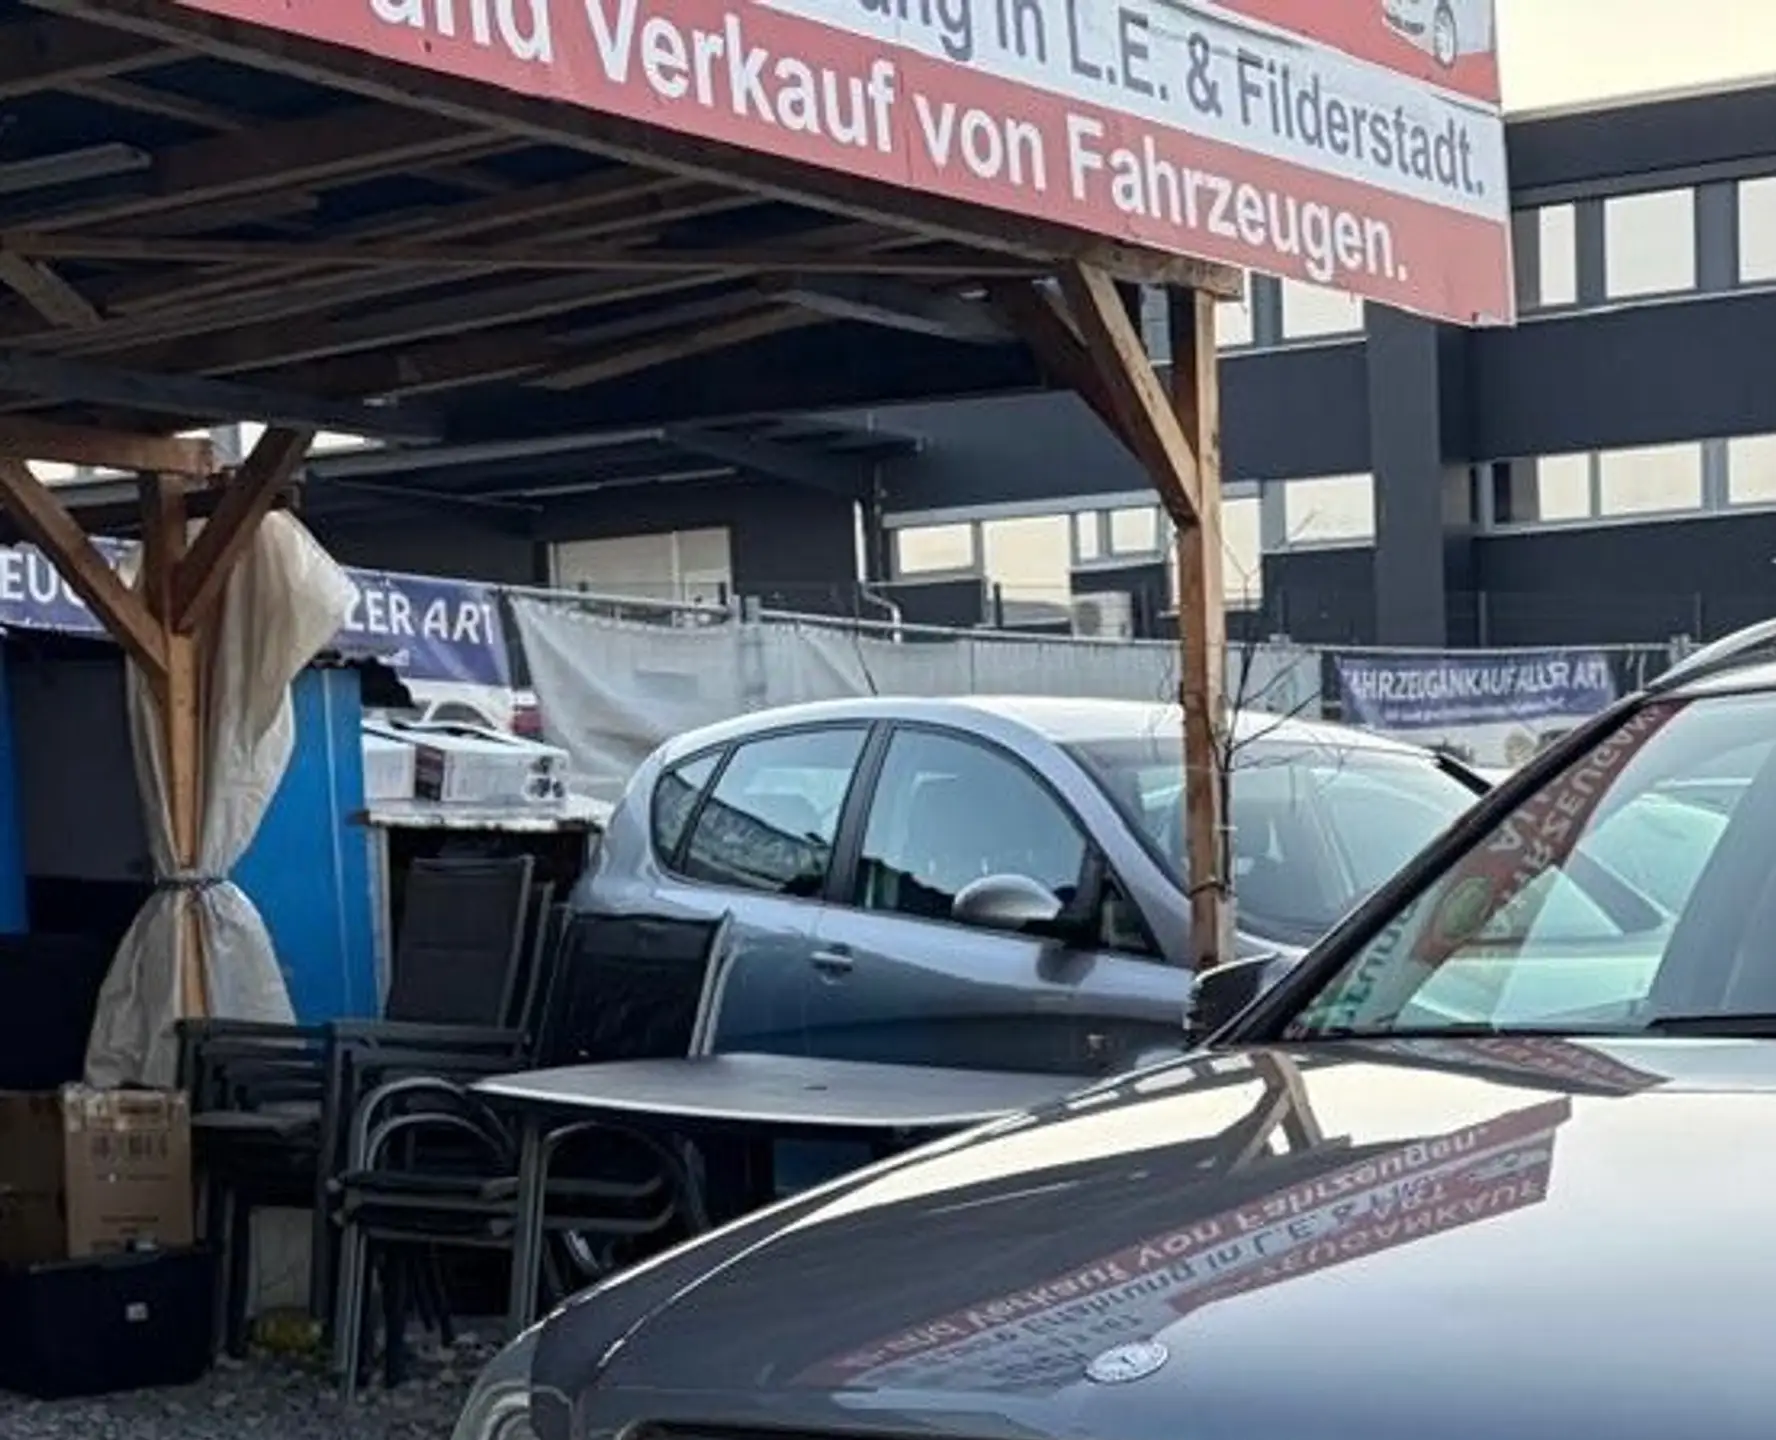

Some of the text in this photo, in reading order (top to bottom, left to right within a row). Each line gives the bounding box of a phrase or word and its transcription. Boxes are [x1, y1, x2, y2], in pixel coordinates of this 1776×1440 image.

[585, 0, 896, 153] Verkauf
[912, 94, 1047, 192] von
[1066, 113, 1408, 282] Fahrzeugen.
[995, 0, 1046, 63] in
[1067, 0, 1168, 101] L.E.
[1186, 31, 1223, 118] &
[1236, 48, 1484, 197] Filderstadt.
[0, 552, 86, 609] EU
